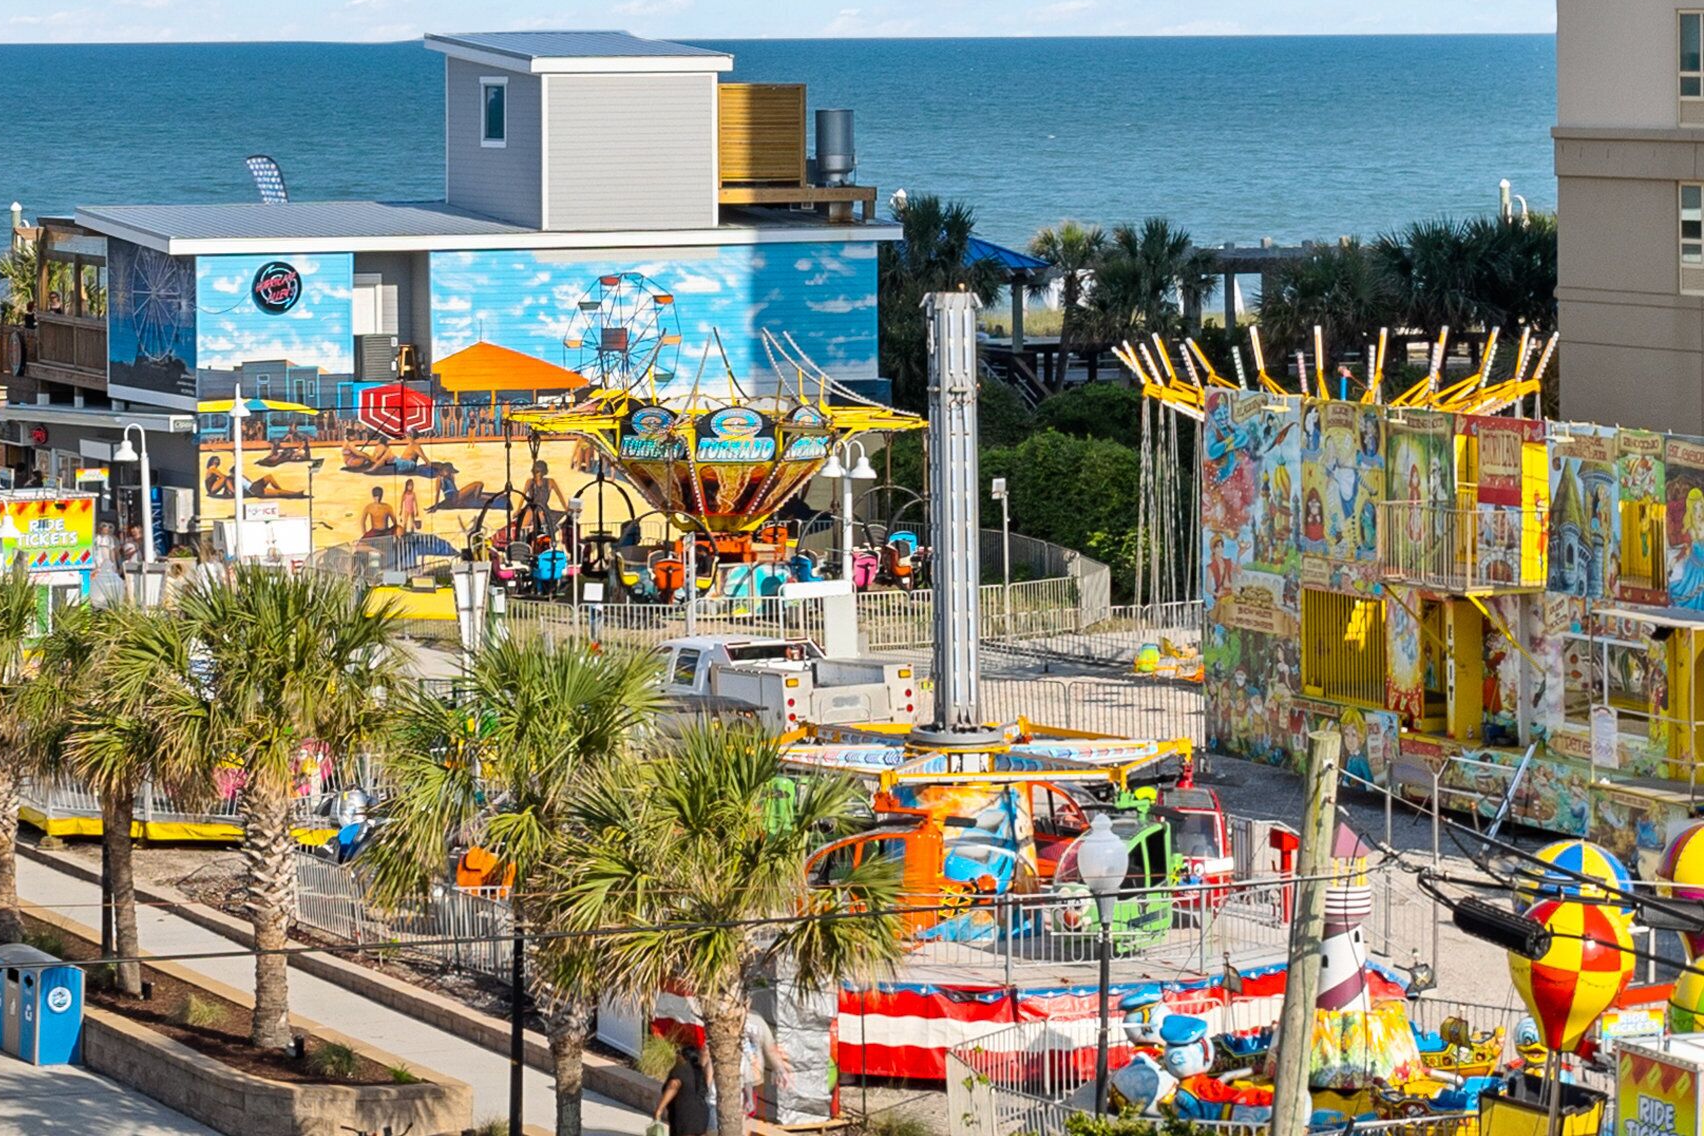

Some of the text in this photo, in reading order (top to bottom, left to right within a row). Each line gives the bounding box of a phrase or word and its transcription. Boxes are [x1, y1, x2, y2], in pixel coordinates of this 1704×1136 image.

[698, 440, 774, 459] TORNADO
[29, 518, 65, 533] RIDE
[18, 532, 78, 546] TICKETS
[1447, 624, 1455, 701] EXIT
[1639, 1095, 1675, 1130] RIDE
